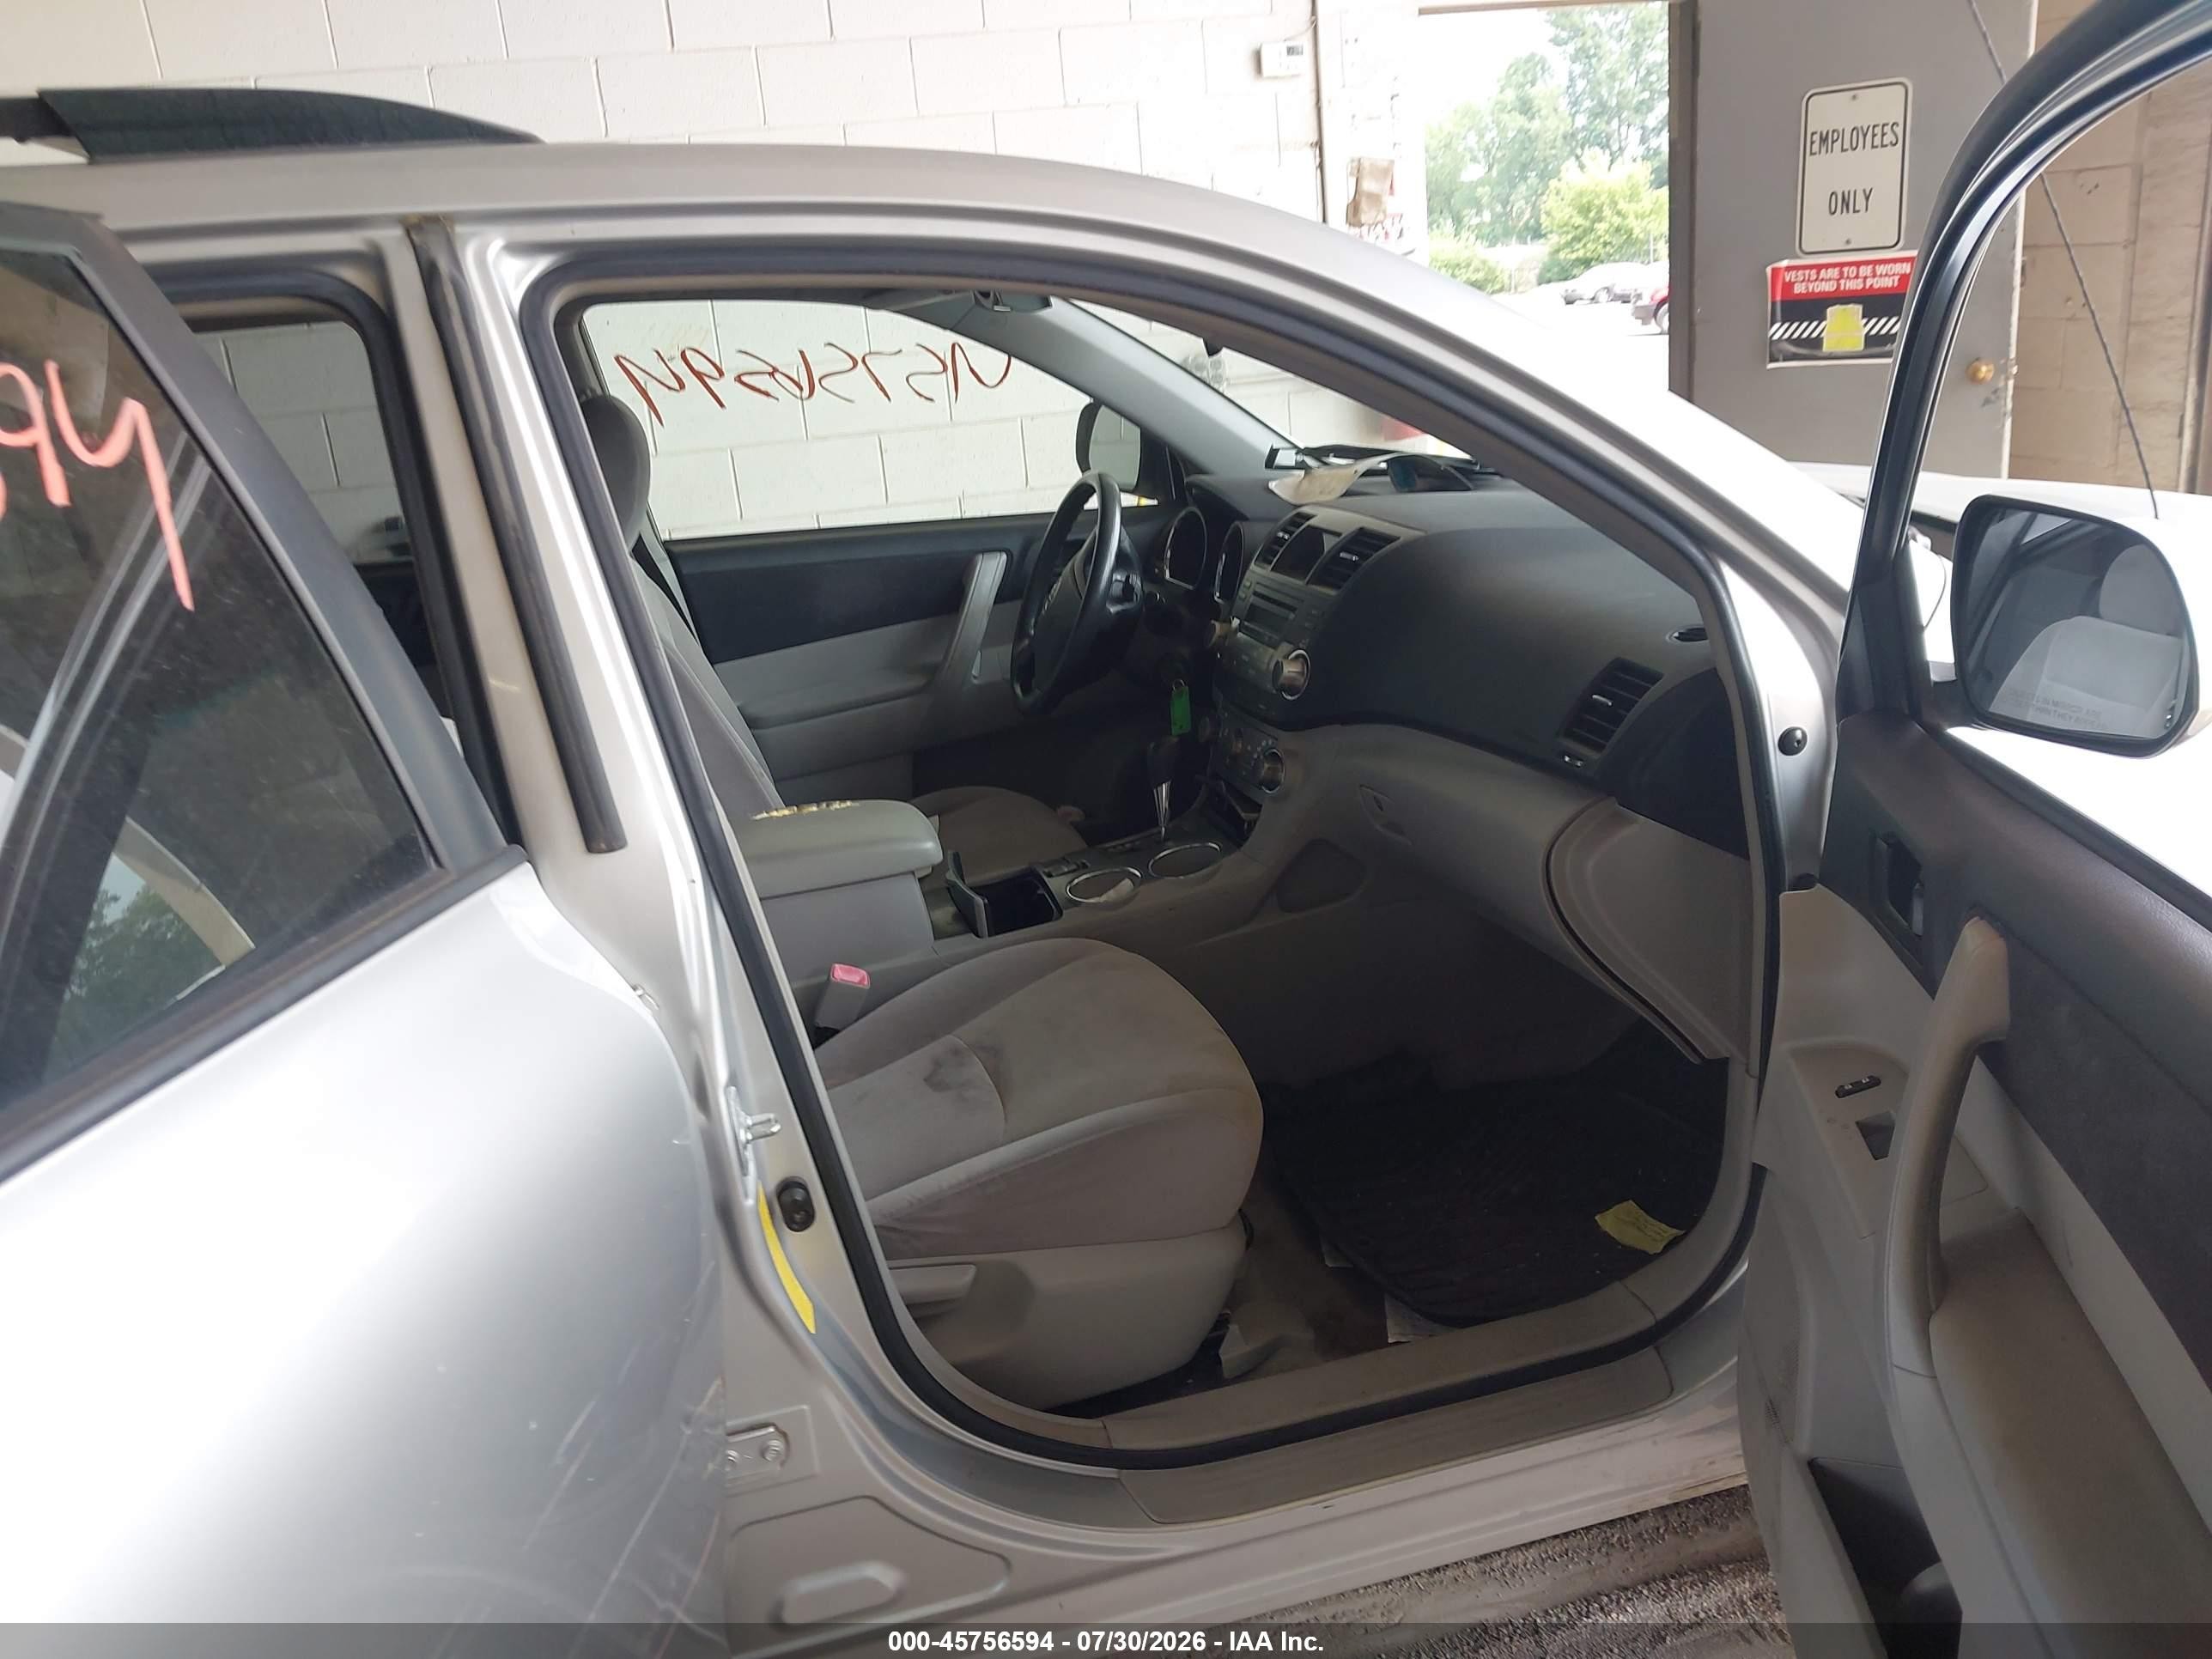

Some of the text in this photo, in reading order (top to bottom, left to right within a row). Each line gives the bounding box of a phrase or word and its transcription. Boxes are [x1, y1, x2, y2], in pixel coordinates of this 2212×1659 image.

[1808, 122, 1899, 156] EMPLOYEES
[1828, 187, 1873, 216] ONLY
[1784, 262, 1911, 283] VESTS ARE TO BE WORN
[1793, 275, 1899, 295] BEYOND THIS POINT
[0, 359, 195, 612] 94
